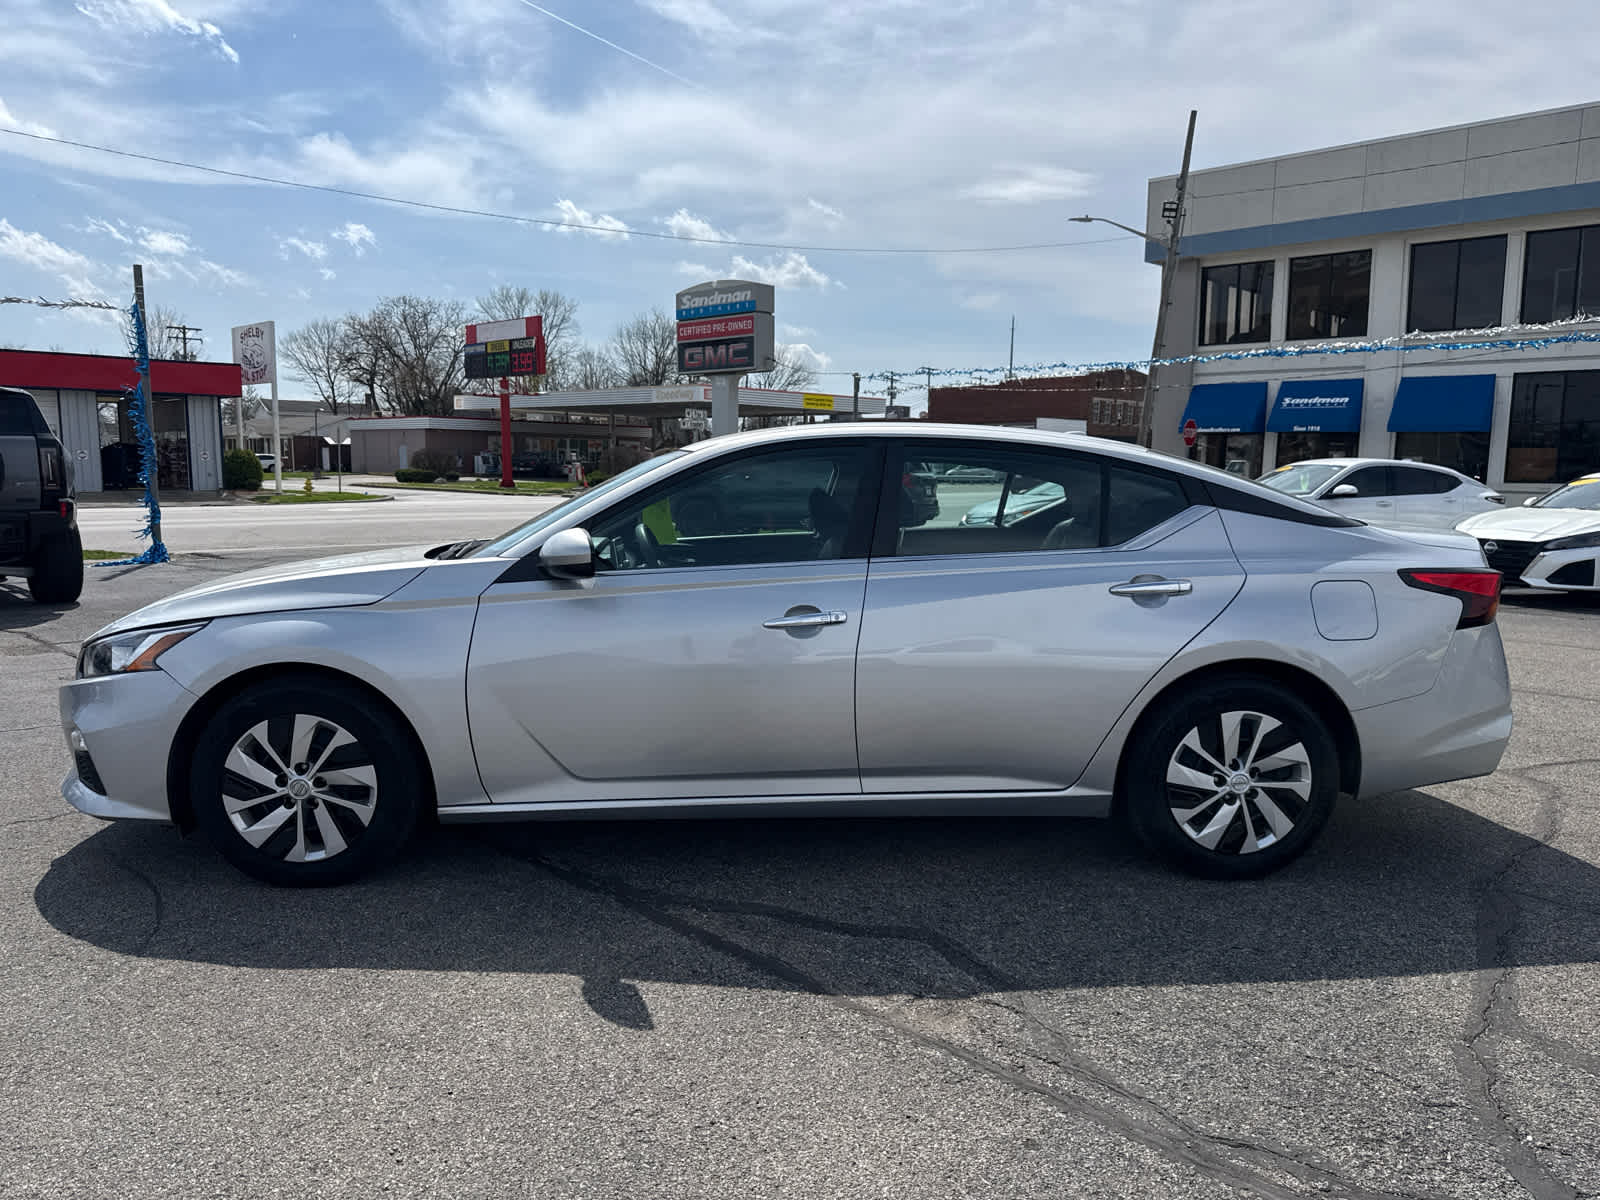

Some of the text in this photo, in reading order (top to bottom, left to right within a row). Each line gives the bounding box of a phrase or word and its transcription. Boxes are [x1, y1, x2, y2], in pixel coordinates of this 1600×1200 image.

[681, 290, 752, 309] Sandman
[240, 327, 264, 344] SHELBY
[679, 319, 753, 337] CERTIFIED PRE-OWNED
[684, 343, 749, 369] GMC
[1282, 396, 1350, 405] Sandman
